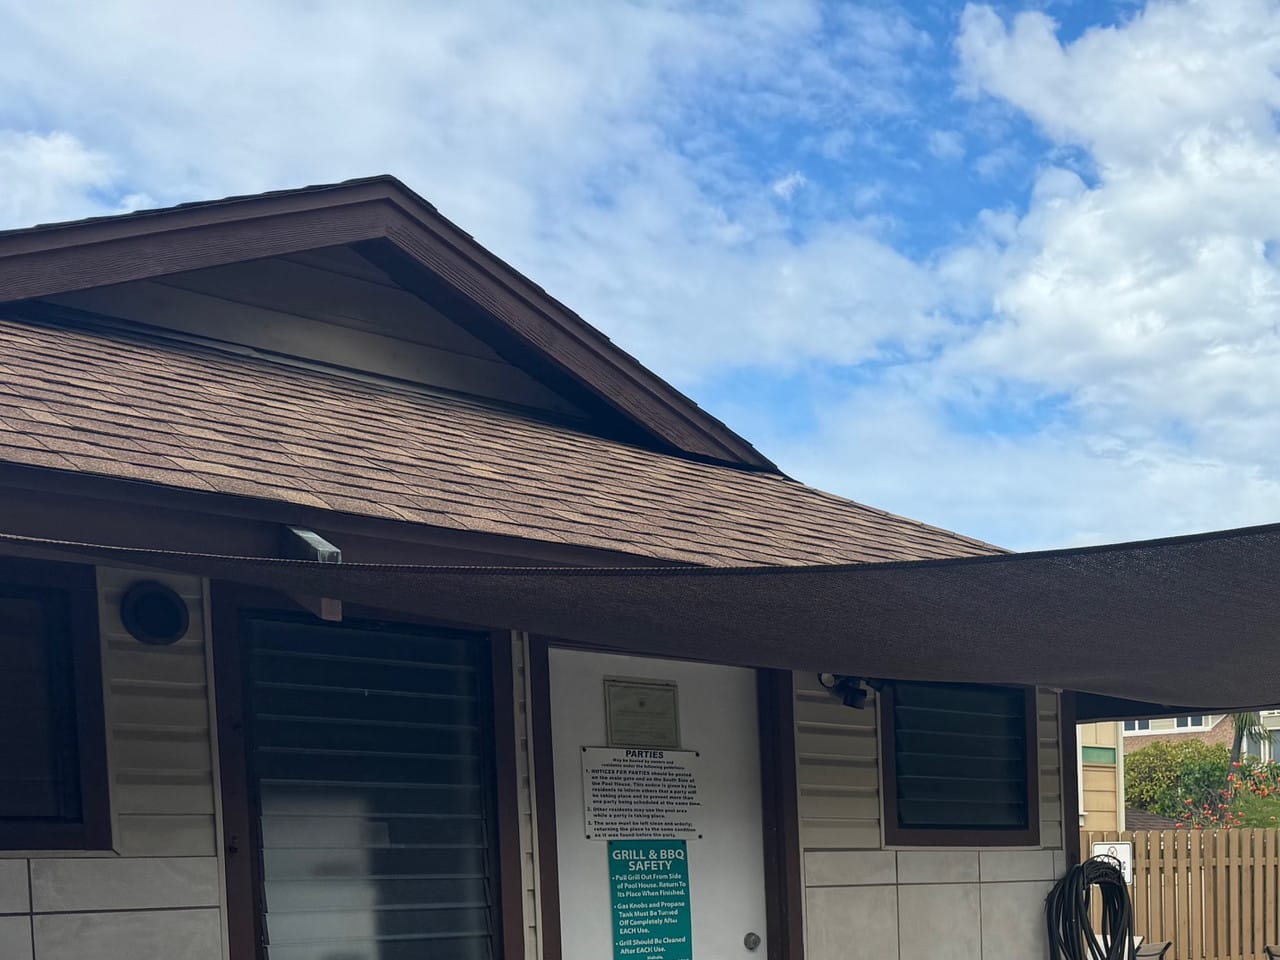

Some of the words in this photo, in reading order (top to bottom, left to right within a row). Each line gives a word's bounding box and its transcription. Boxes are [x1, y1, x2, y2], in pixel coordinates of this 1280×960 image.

[626, 750, 663, 759] PARTIES
[612, 850, 646, 860] GRILL
[648, 850, 658, 860] &
[659, 850, 684, 860] BBQ
[629, 861, 672, 871] SAFETY
